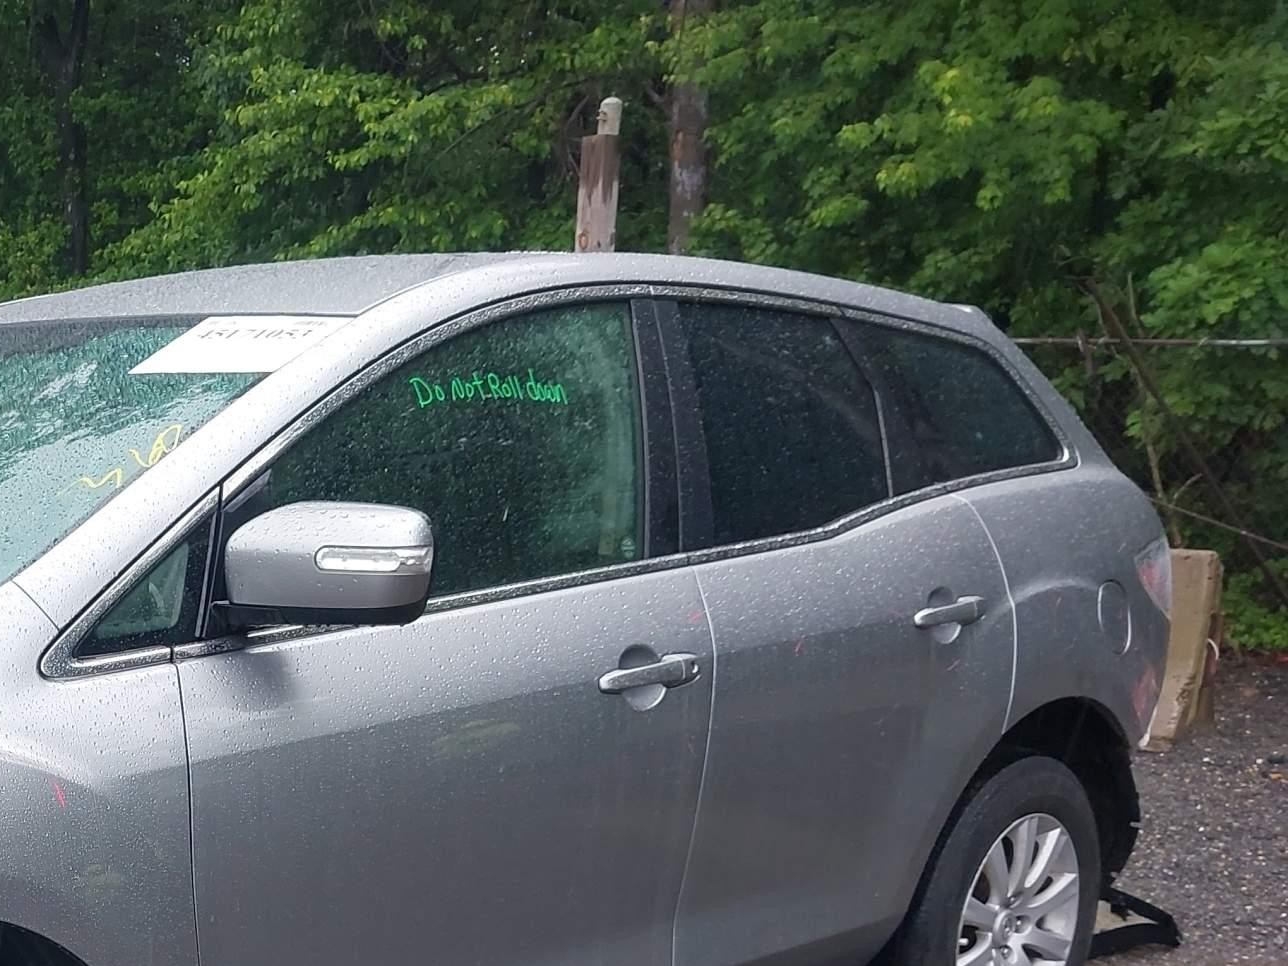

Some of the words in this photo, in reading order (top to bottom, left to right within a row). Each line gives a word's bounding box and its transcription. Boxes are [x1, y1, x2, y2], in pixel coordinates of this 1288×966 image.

[409, 377, 445, 408] Do
[452, 371, 487, 401] Not
[487, 373, 524, 400] Roll
